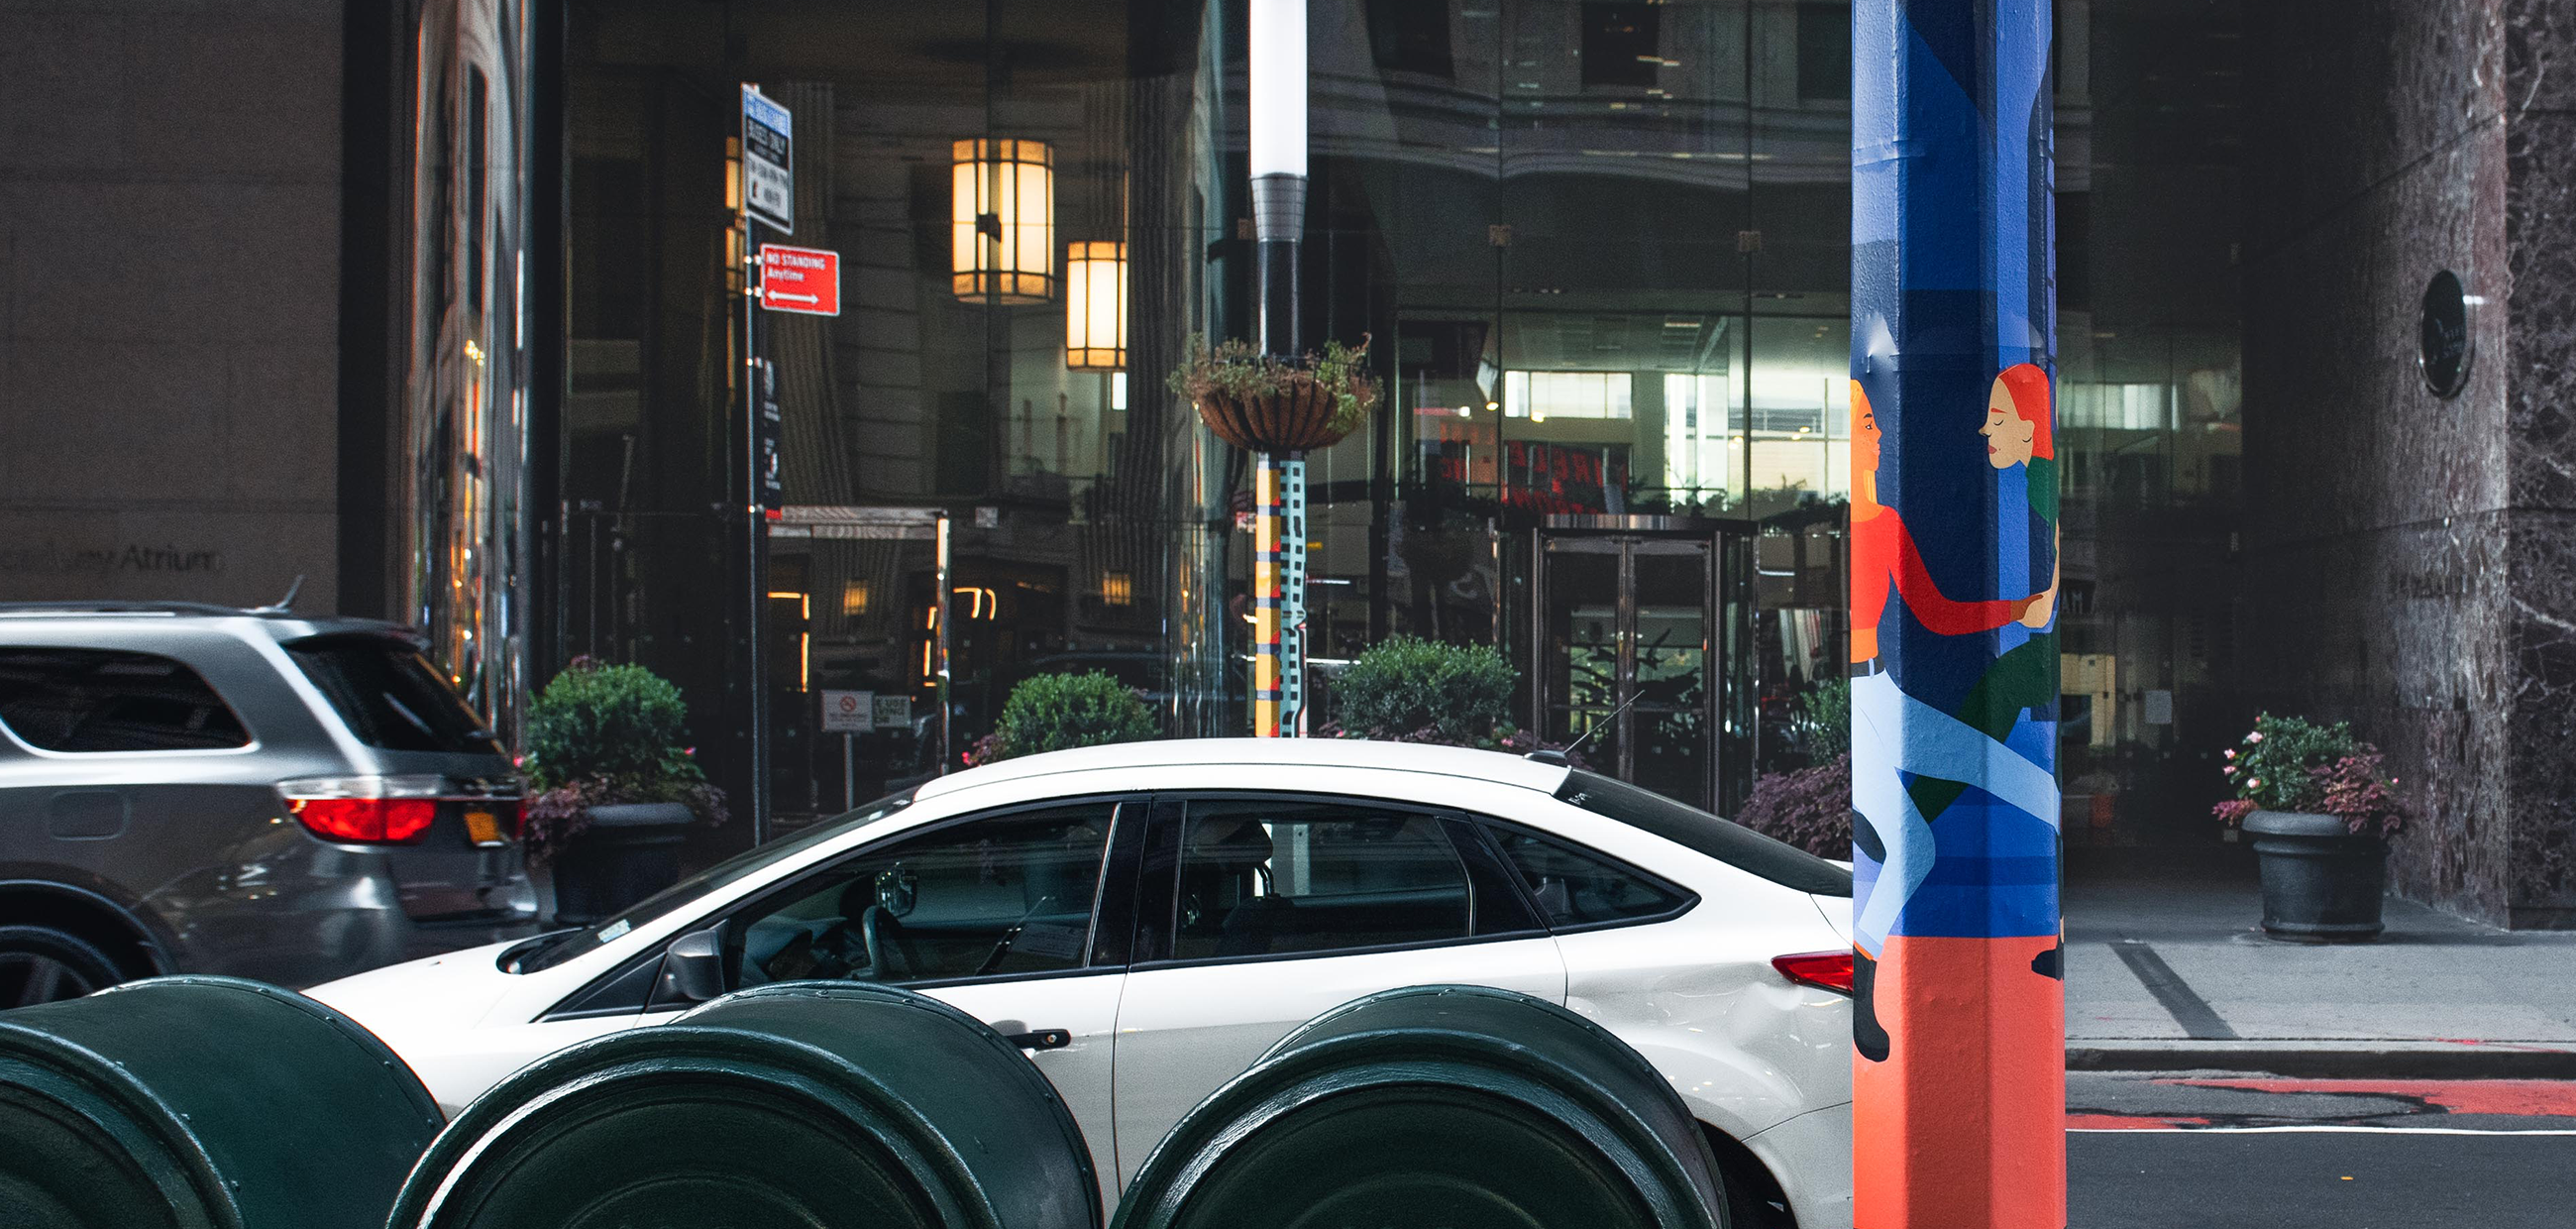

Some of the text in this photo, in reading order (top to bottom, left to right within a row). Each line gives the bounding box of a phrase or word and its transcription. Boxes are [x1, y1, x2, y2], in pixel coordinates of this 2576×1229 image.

[767, 253, 825, 271] NO STANDING
[768, 267, 805, 281] Anytime
